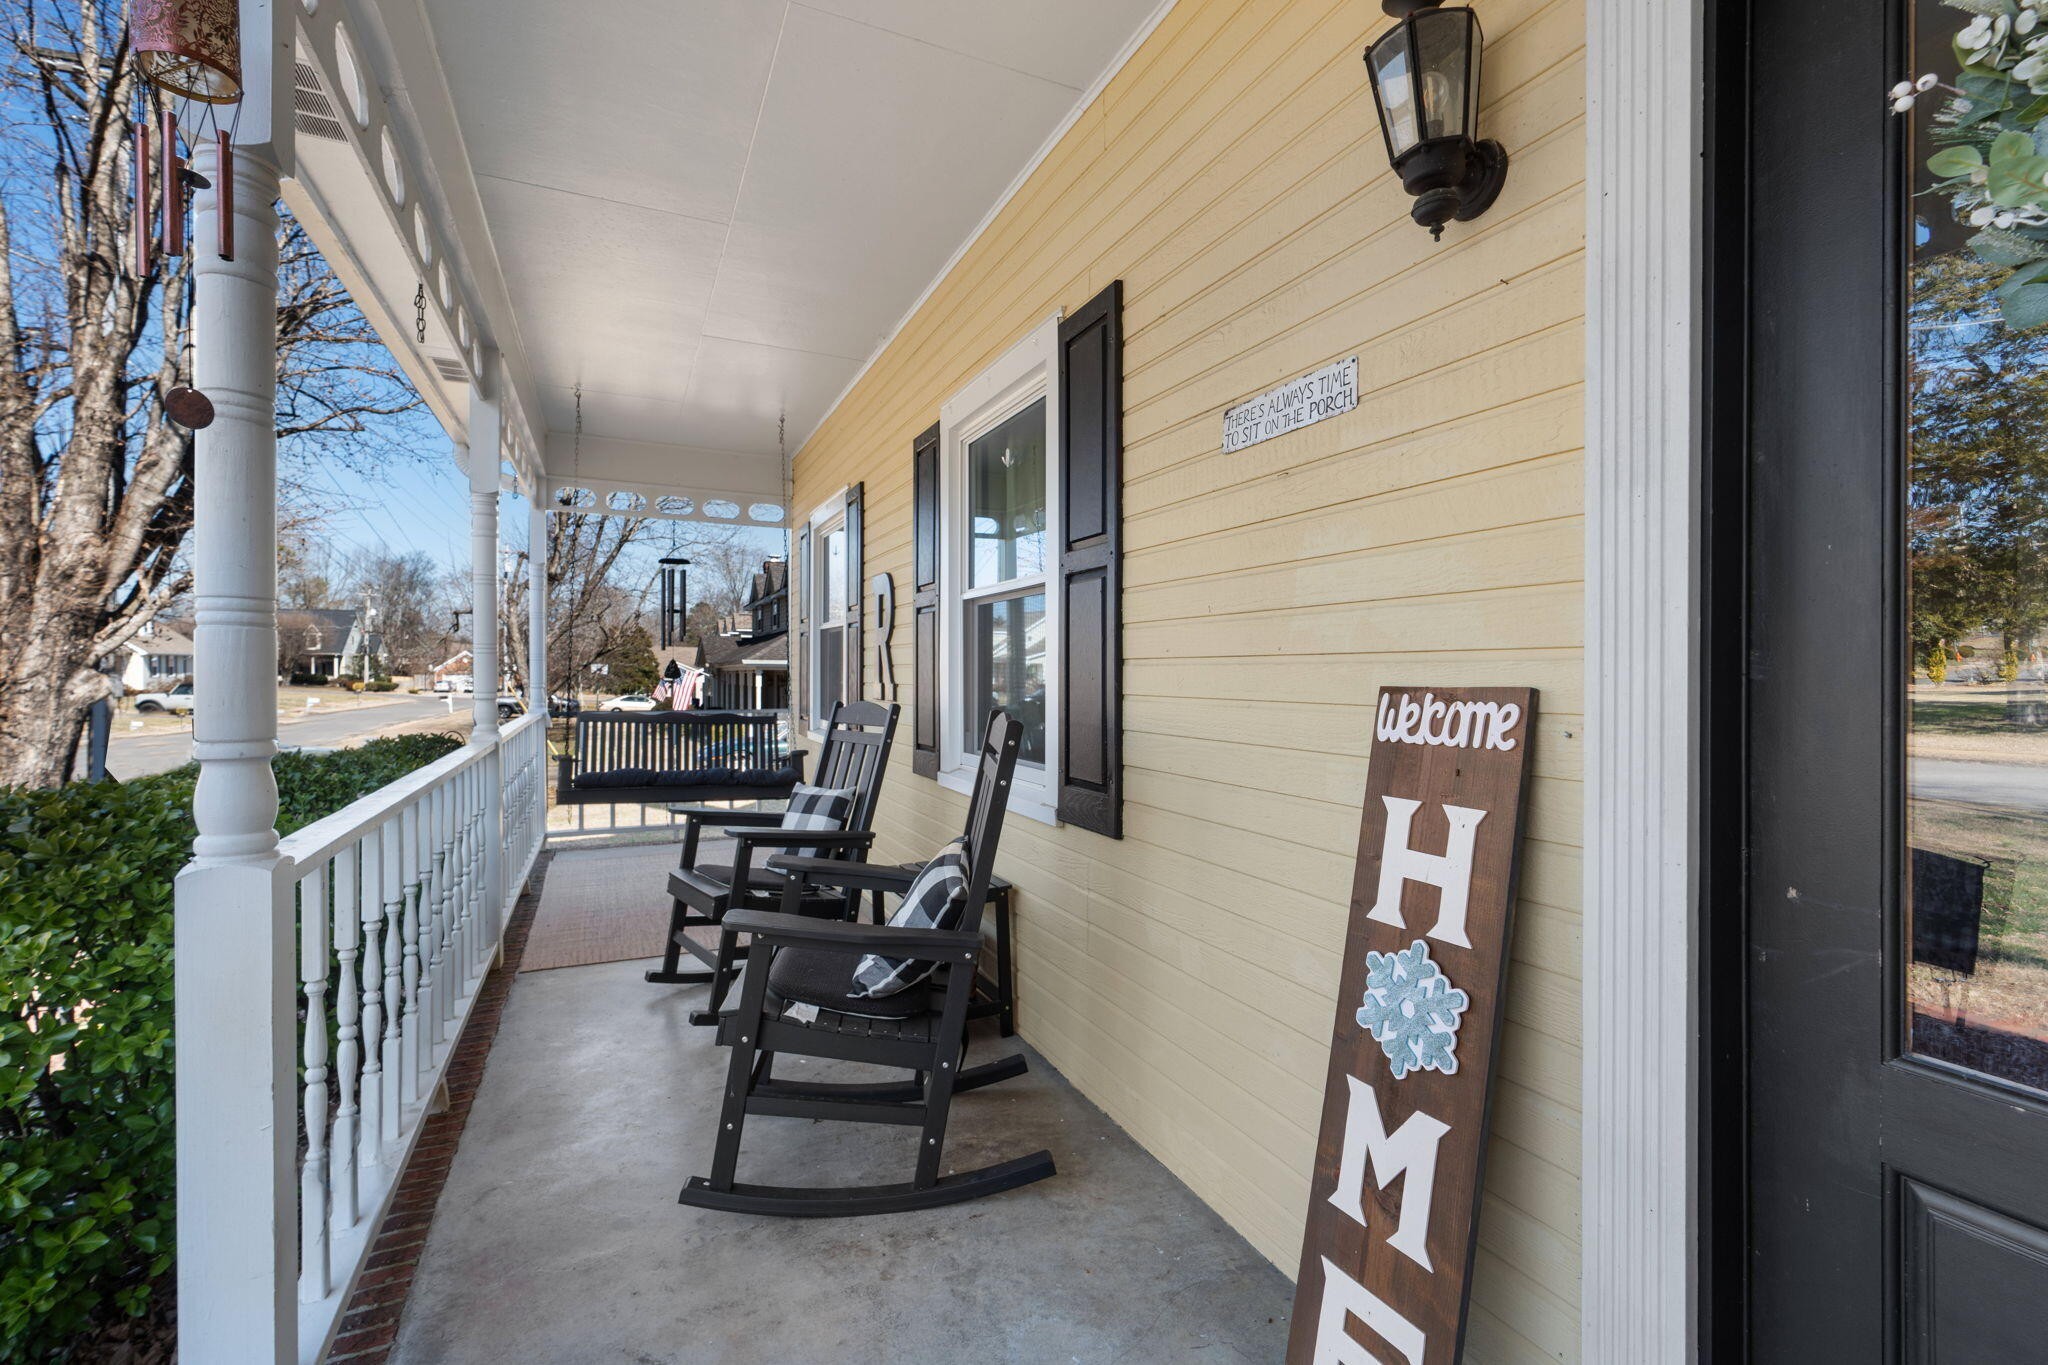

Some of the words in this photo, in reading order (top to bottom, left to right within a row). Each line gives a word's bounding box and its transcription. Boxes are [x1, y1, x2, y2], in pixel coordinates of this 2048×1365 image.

[1225, 430, 1239, 448] TO
[1242, 422, 1261, 443] SIT
[1264, 416, 1279, 435] ON
[1283, 407, 1304, 428] THE
[1309, 387, 1355, 419] PORCH.
[1226, 403, 1265, 431] THERE'S
[1268, 381, 1314, 416] ALWAYS
[1318, 365, 1351, 394] TIME
